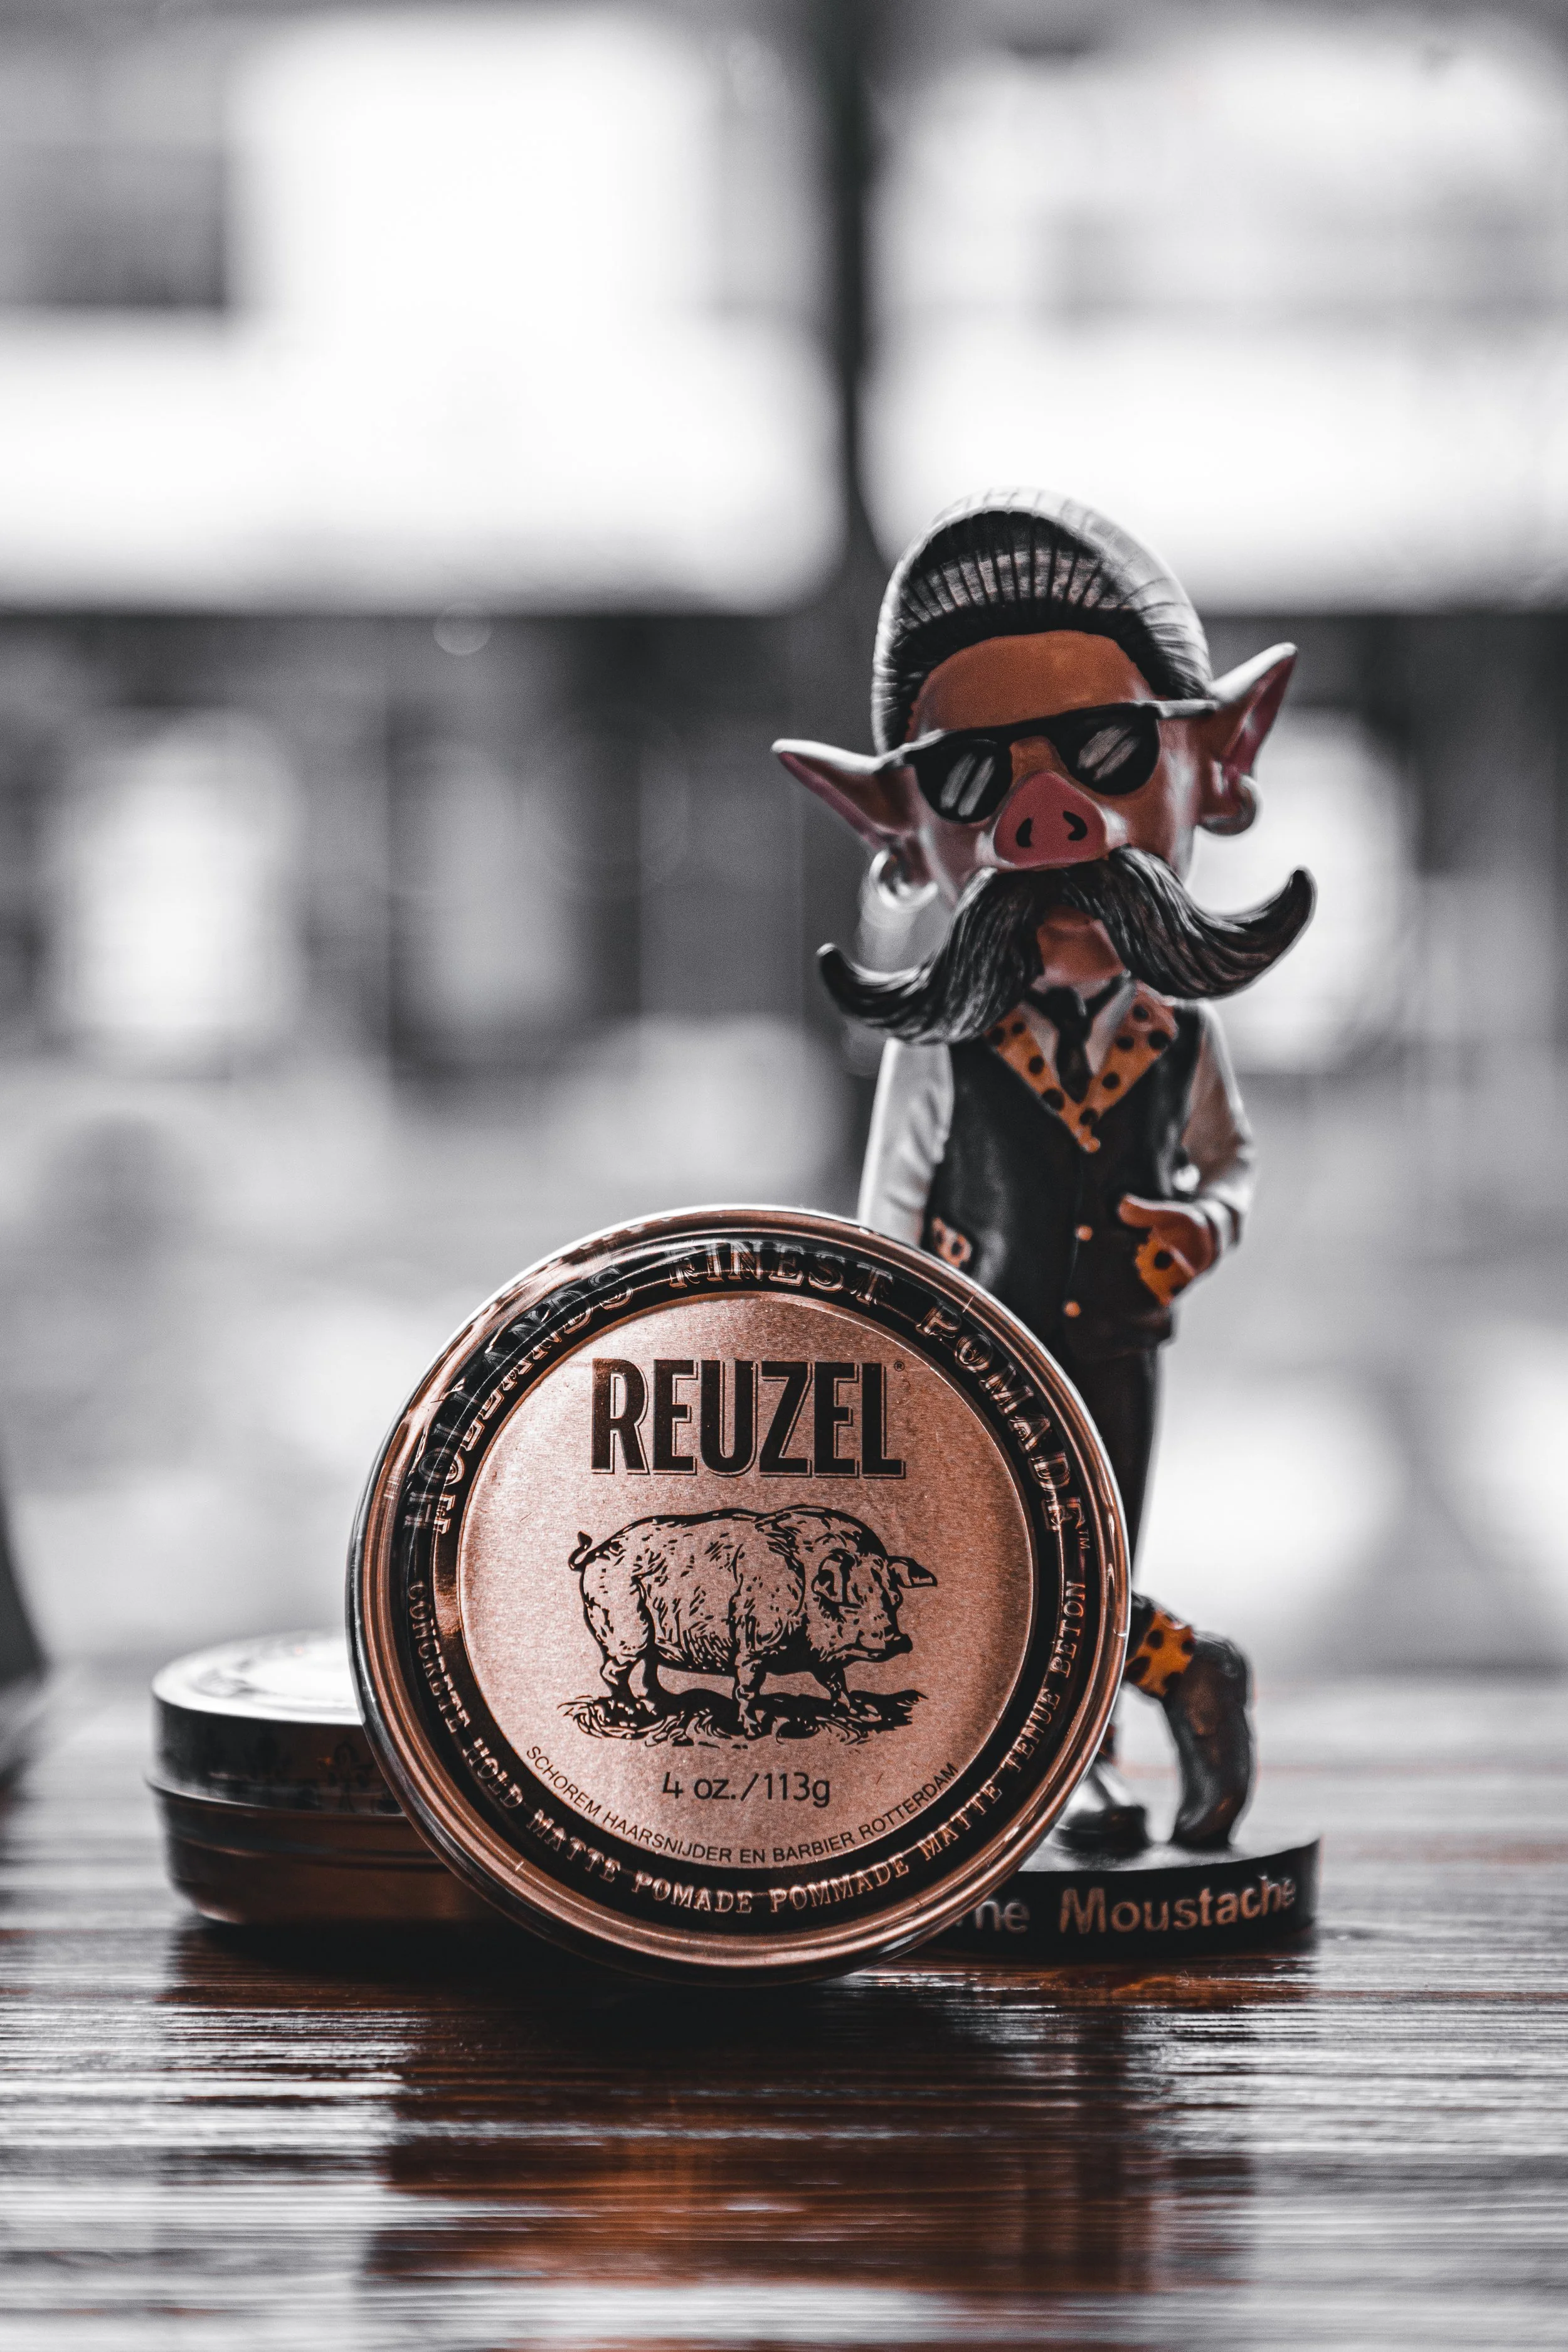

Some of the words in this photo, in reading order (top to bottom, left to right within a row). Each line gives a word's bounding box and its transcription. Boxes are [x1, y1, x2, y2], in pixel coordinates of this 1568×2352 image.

[666, 1240, 894, 1307] FINEST
[409, 1581, 470, 1734] CONCRETE
[463, 1737, 523, 1808] HOLD
[526, 1809, 621, 1883] MATTE
[632, 1870, 753, 1914] POMADE
[768, 1853, 909, 1912] POMMADE
[916, 1779, 1003, 1861] MATTE
[1000, 1688, 1061, 1772] TENUE
[526, 1746, 602, 1817] SCHOREM
[603, 1811, 731, 1863] HAARSNIJDER
[739, 1848, 765, 1863] EN
[773, 1831, 856, 1863] BARBIER
[858, 1762, 959, 1840] ROTTERDAM
[662, 1771, 684, 1799] 4
[693, 1772, 830, 1808] oz./113g
[1059, 1873, 1297, 1934] Moustache
